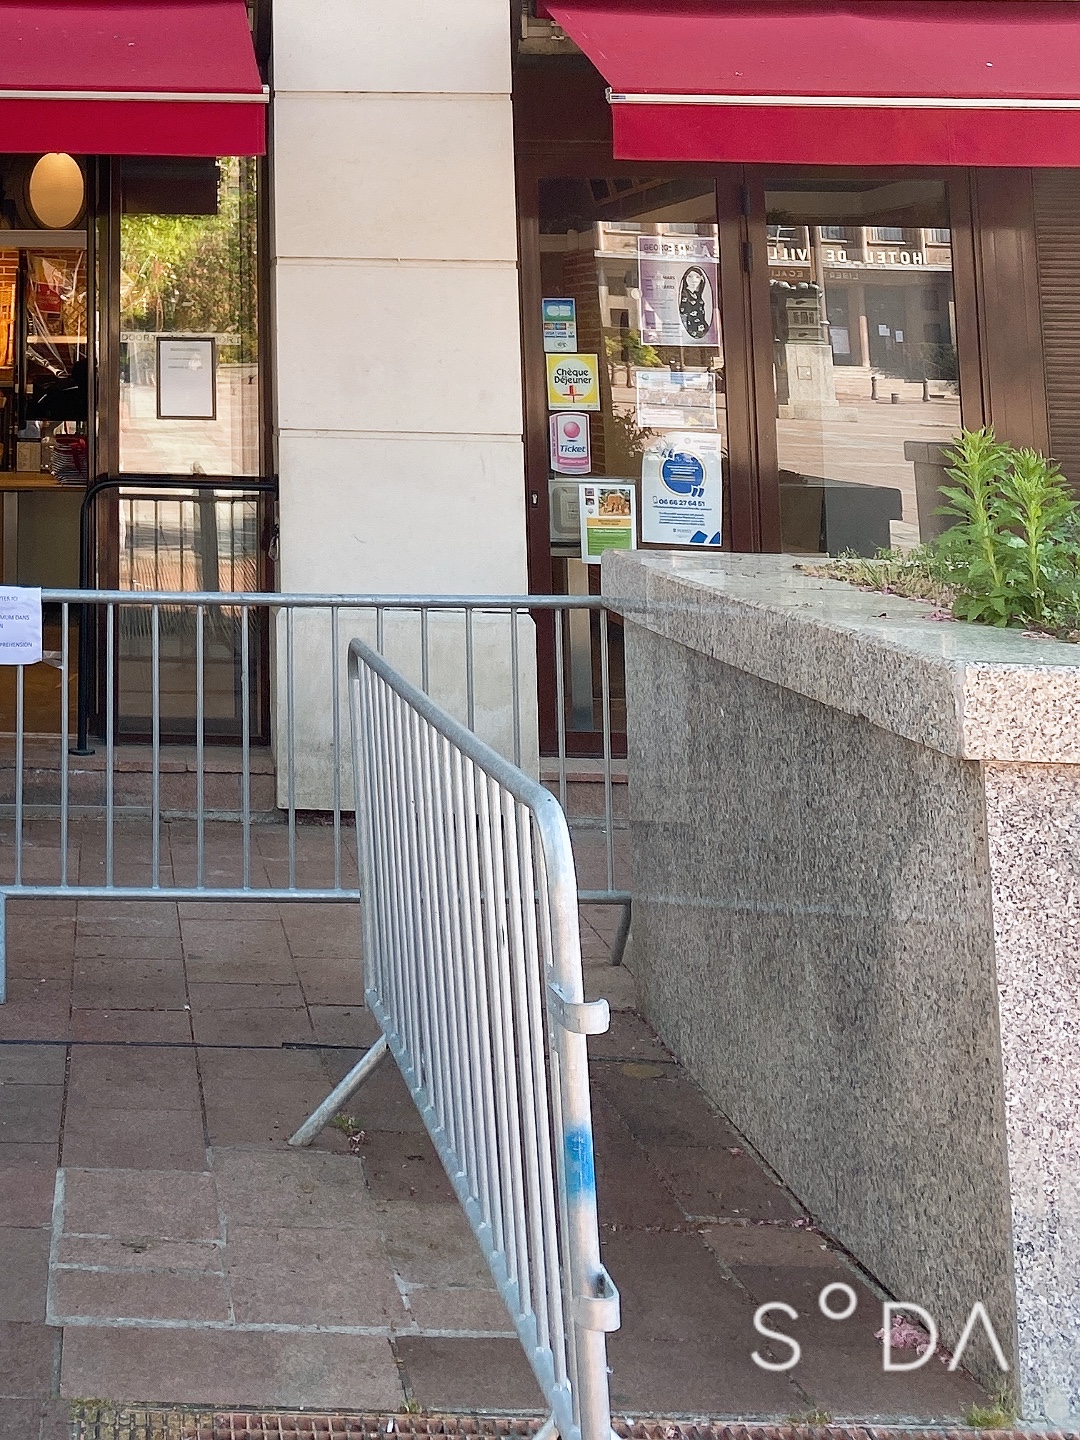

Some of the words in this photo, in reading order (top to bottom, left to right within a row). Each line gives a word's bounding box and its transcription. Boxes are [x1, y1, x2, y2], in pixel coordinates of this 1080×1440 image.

[556, 368, 589, 378] Chèque
[554, 375, 592, 385] Déjeuner
[560, 444, 586, 453] Ticket
